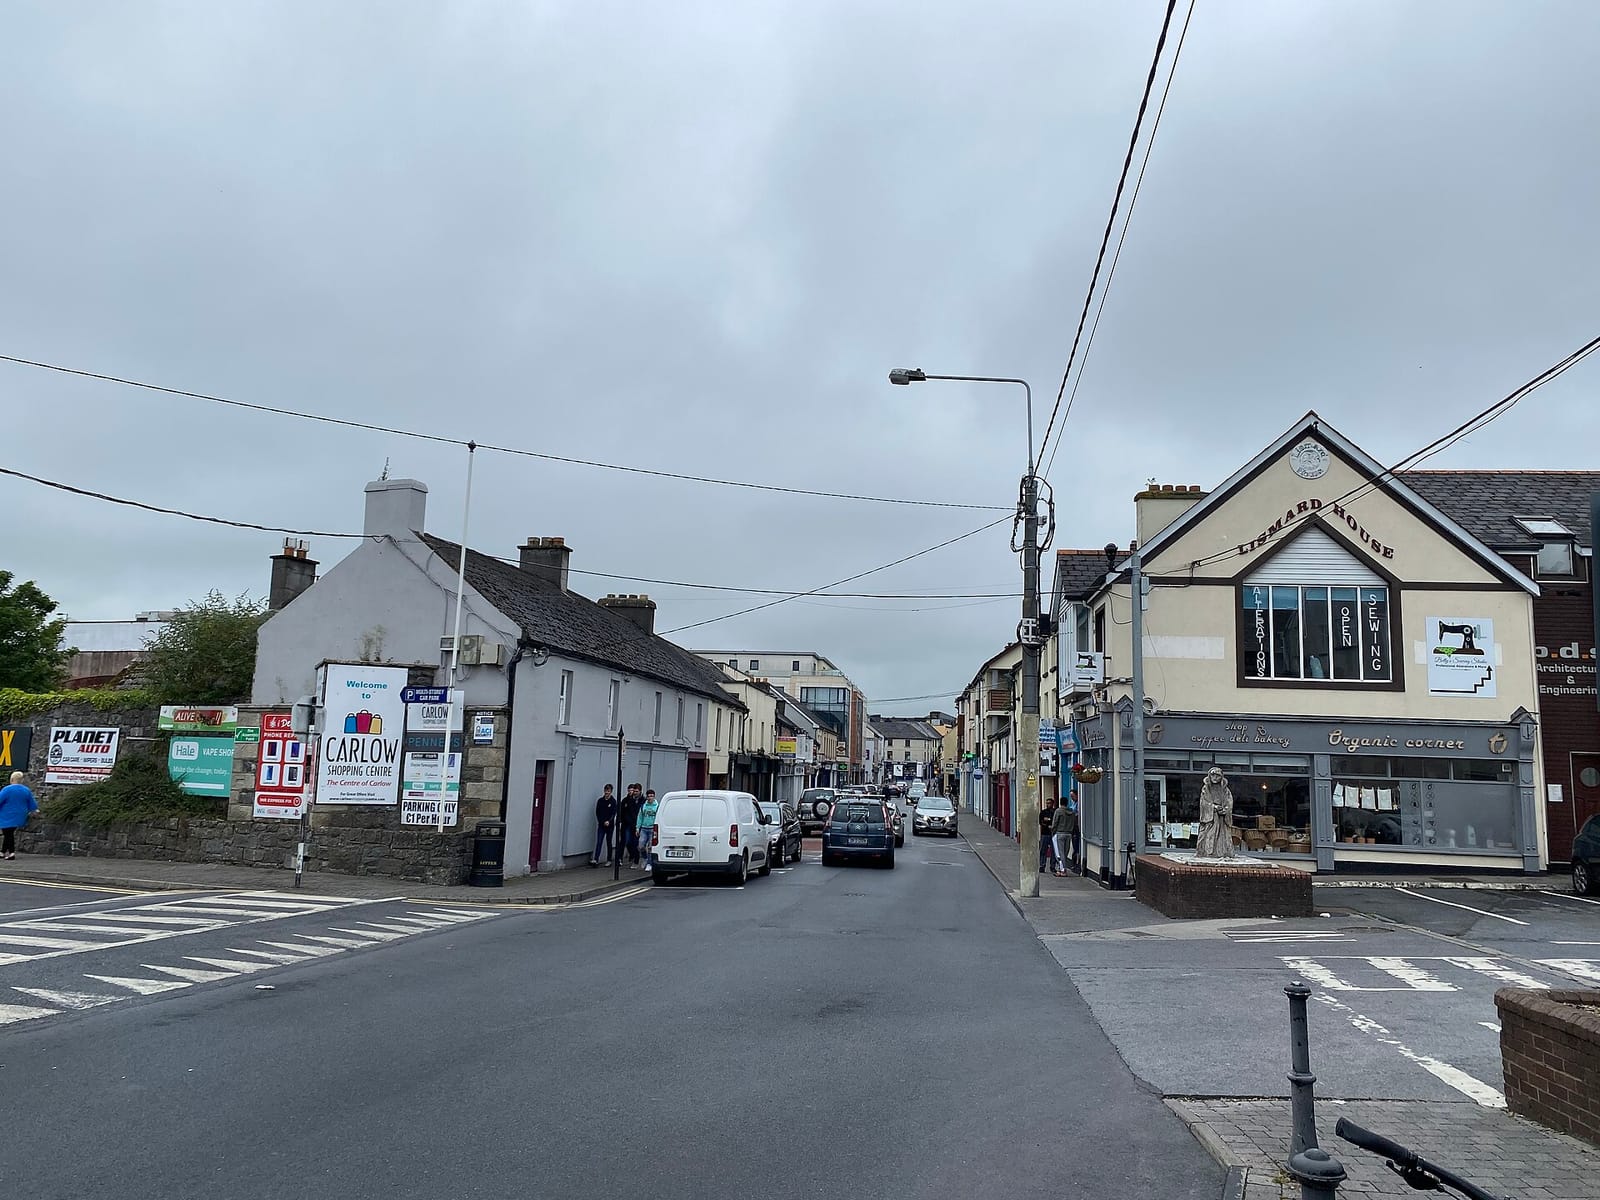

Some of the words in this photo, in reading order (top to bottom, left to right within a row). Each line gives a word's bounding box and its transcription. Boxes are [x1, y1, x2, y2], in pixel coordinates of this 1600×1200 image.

[1238, 498, 1322, 555] LISMARD
[1333, 501, 1394, 559] HOUSE
[1252, 586, 1266, 677] ALTERATIONS
[1341, 606, 1352, 647] OPEN
[1368, 593, 1382, 671] SEWING
[346, 680, 387, 689] Welcome
[1566, 675, 1575, 684] &
[407, 690, 413, 699] P
[1539, 685, 1597, 696] Engineerin
[175, 712, 195, 721] ALIVE
[422, 706, 448, 718] CARLOW
[1225, 722, 1248, 734] shop
[53, 730, 117, 743] PLANET
[408, 737, 460, 748] PENNES
[1191, 735, 1225, 748] coffee
[1230, 734, 1249, 743] deli
[1254, 734, 1290, 748] bakery
[1328, 729, 1398, 752] Organic
[1405, 738, 1465, 750] corner
[78, 744, 110, 753] AUTO
[175, 745, 195, 756] Hale
[203, 748, 218, 756] VAPE
[326, 736, 399, 763] CARLOW
[327, 765, 363, 777] SHOPPING
[366, 765, 392, 777] CENTRE
[403, 802, 436, 813] PARKING
[416, 813, 430, 825] Per
